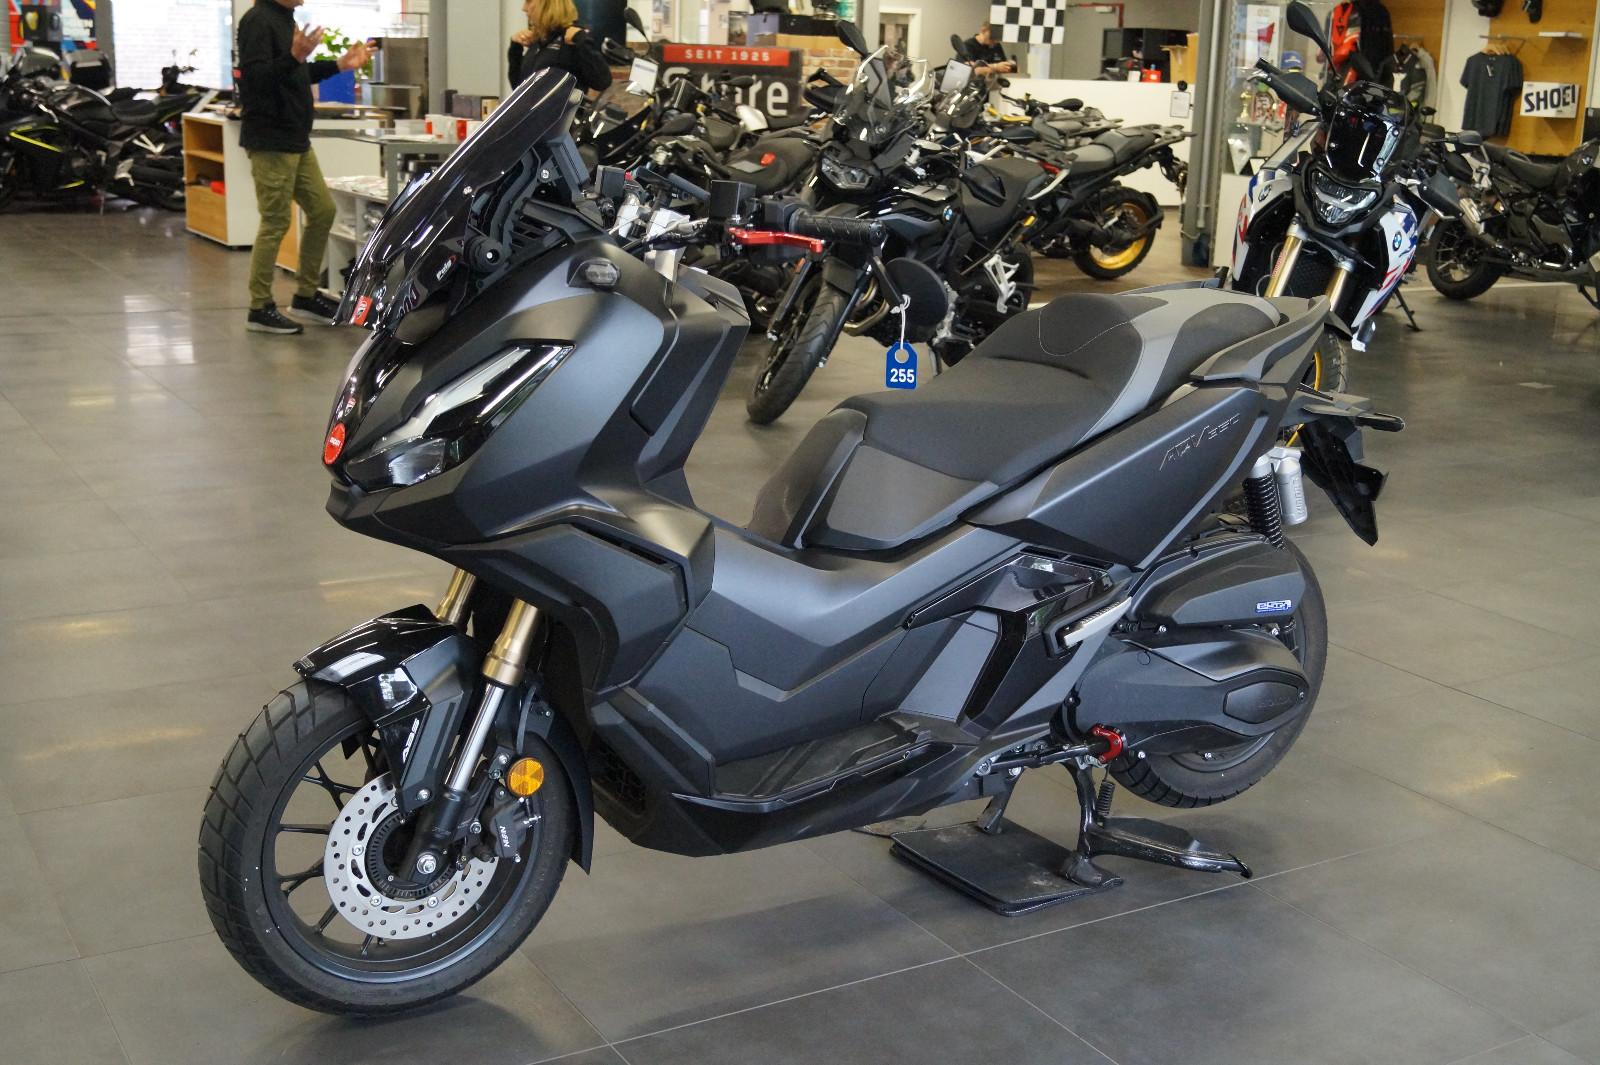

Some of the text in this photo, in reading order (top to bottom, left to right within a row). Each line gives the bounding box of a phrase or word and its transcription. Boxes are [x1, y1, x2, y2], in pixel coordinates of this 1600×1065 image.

[684, 49, 770, 62] SEIT 1925
[1524, 84, 1576, 113] SHOEI
[890, 368, 915, 384] 255
